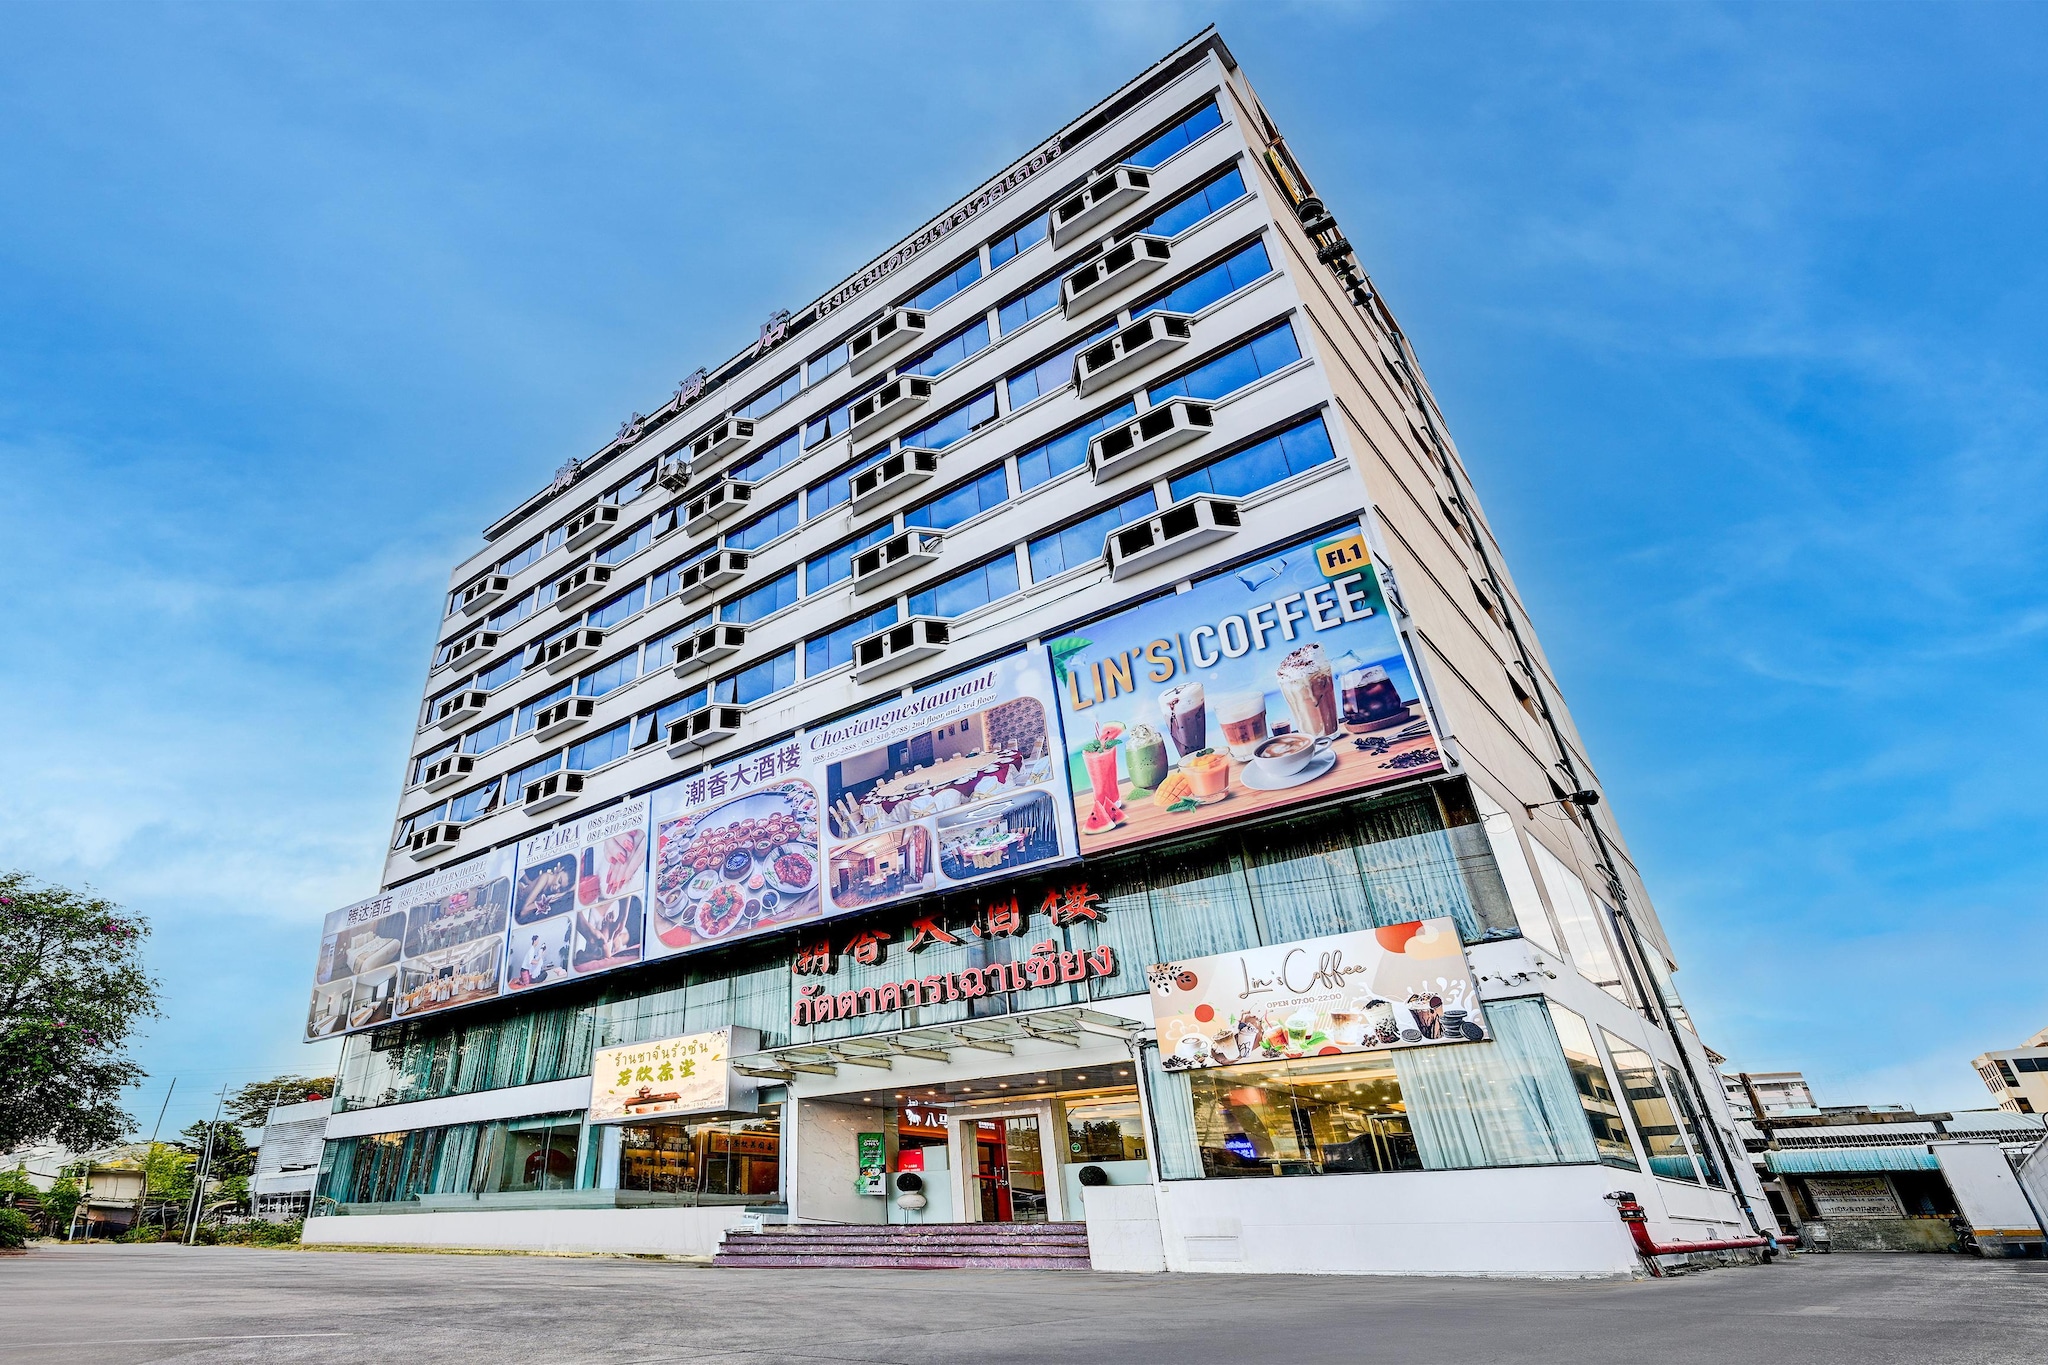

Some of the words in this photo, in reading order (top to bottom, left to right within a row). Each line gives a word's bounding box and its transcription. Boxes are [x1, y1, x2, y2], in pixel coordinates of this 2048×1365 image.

[1068, 639, 1174, 712] LIN'S
[1188, 572, 1375, 668] COFFEE
[686, 743, 801, 807] 潮香大酒楼
[791, 938, 1115, 1026] ภัตตาคารเฉาเซียง
[1239, 956, 1284, 999] Lin's
[1282, 948, 1368, 994] Coffee
[1266, 1001, 1290, 1009] OPEN
